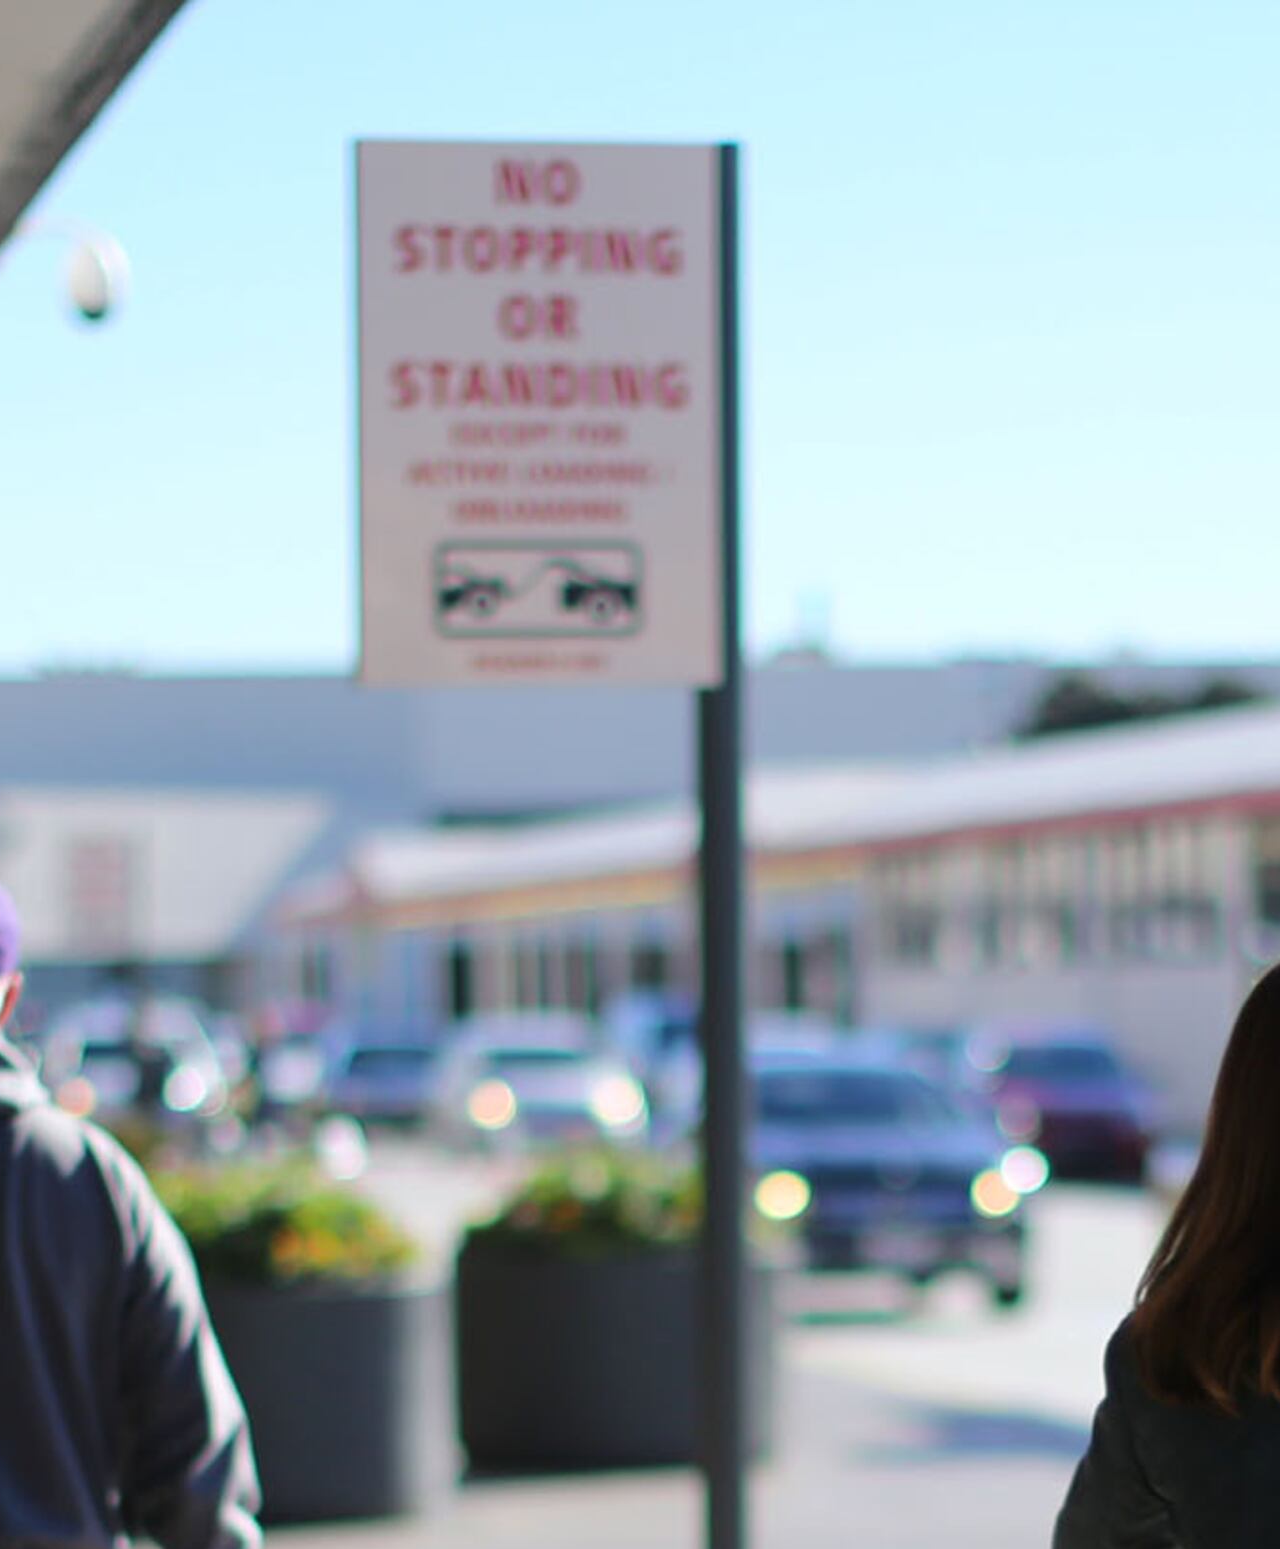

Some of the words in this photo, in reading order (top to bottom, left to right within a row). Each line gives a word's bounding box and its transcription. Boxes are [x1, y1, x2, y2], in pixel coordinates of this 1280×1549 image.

[494, 160, 579, 206] NO
[392, 226, 684, 276] STOPPING
[498, 296, 579, 341] OR
[390, 363, 690, 410] STANDING
